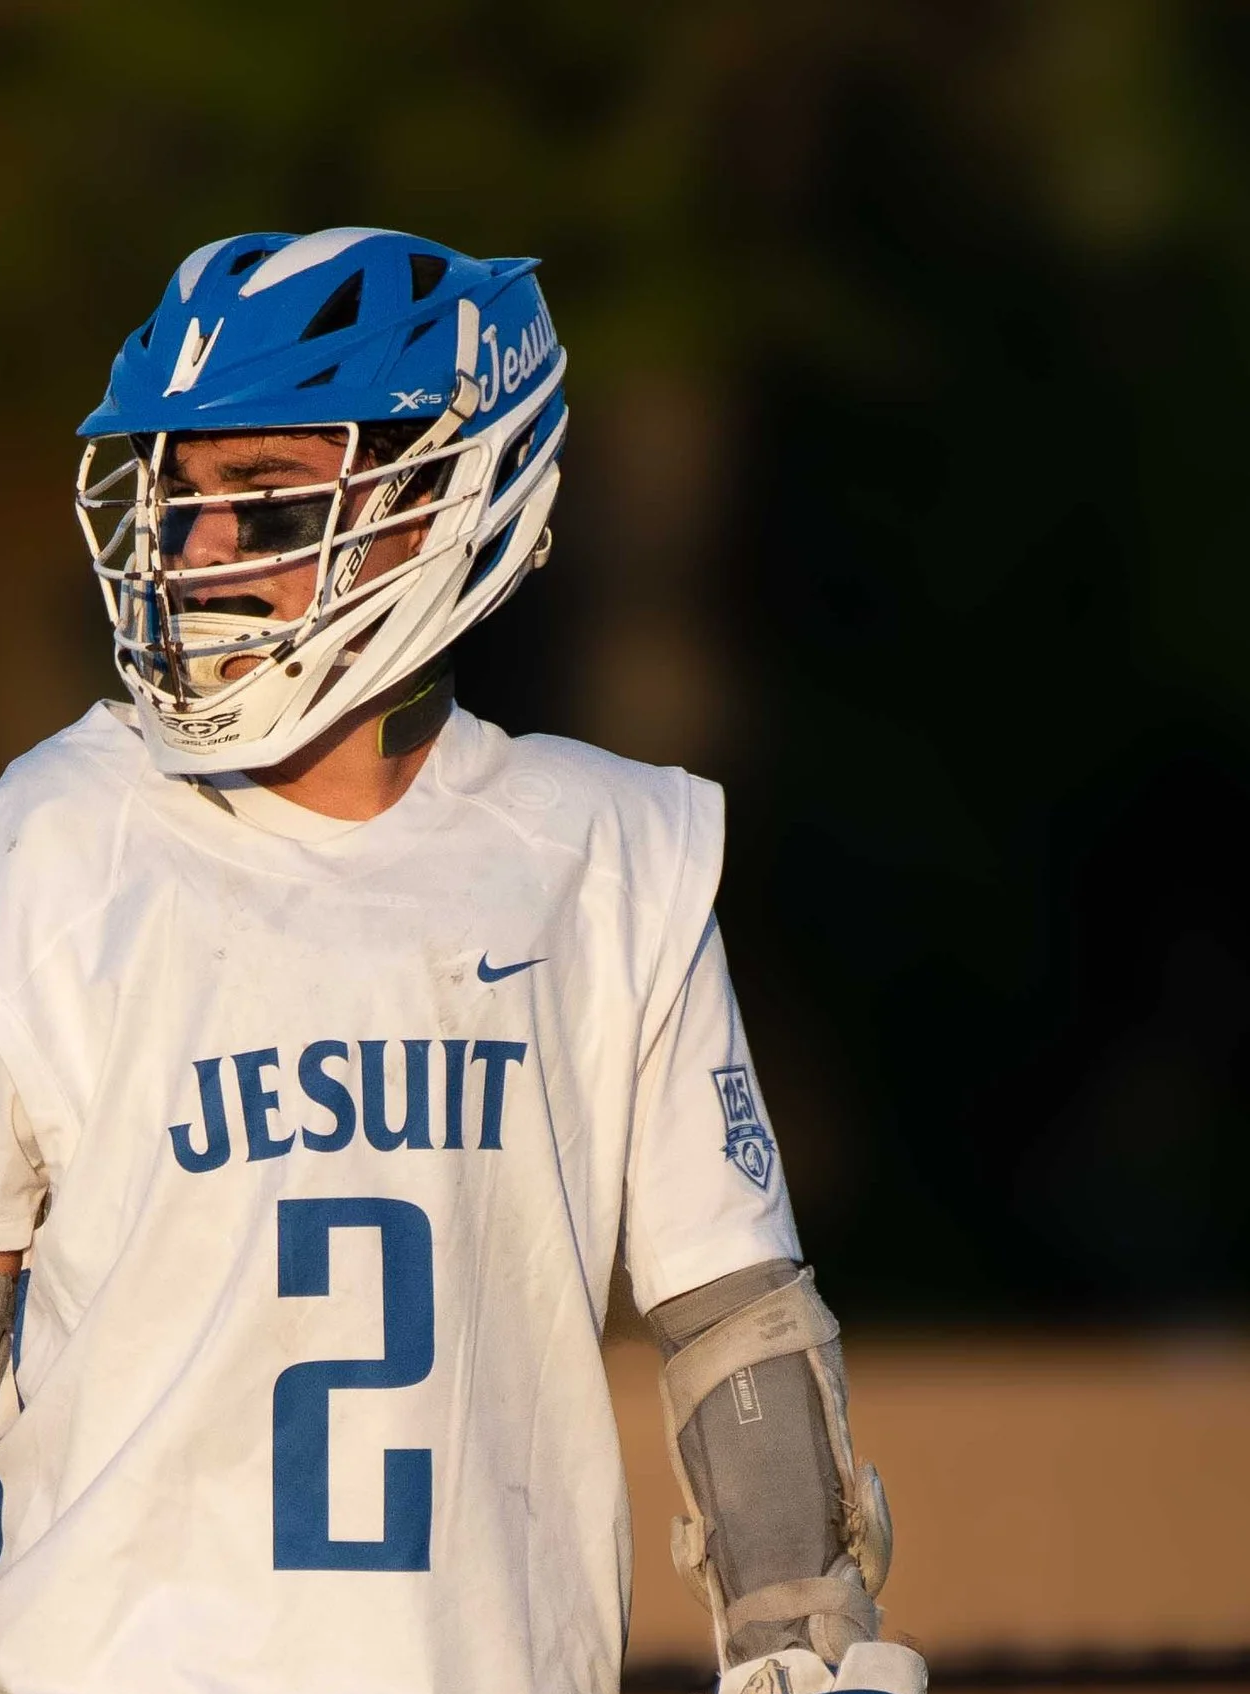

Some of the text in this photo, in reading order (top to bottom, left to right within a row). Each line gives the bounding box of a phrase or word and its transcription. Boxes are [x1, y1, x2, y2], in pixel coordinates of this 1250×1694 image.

[390, 388, 442, 413] XRS
[174, 733, 241, 747] cascade
[167, 1039, 528, 1174] JESUIT
[272, 1197, 435, 1572] 2
